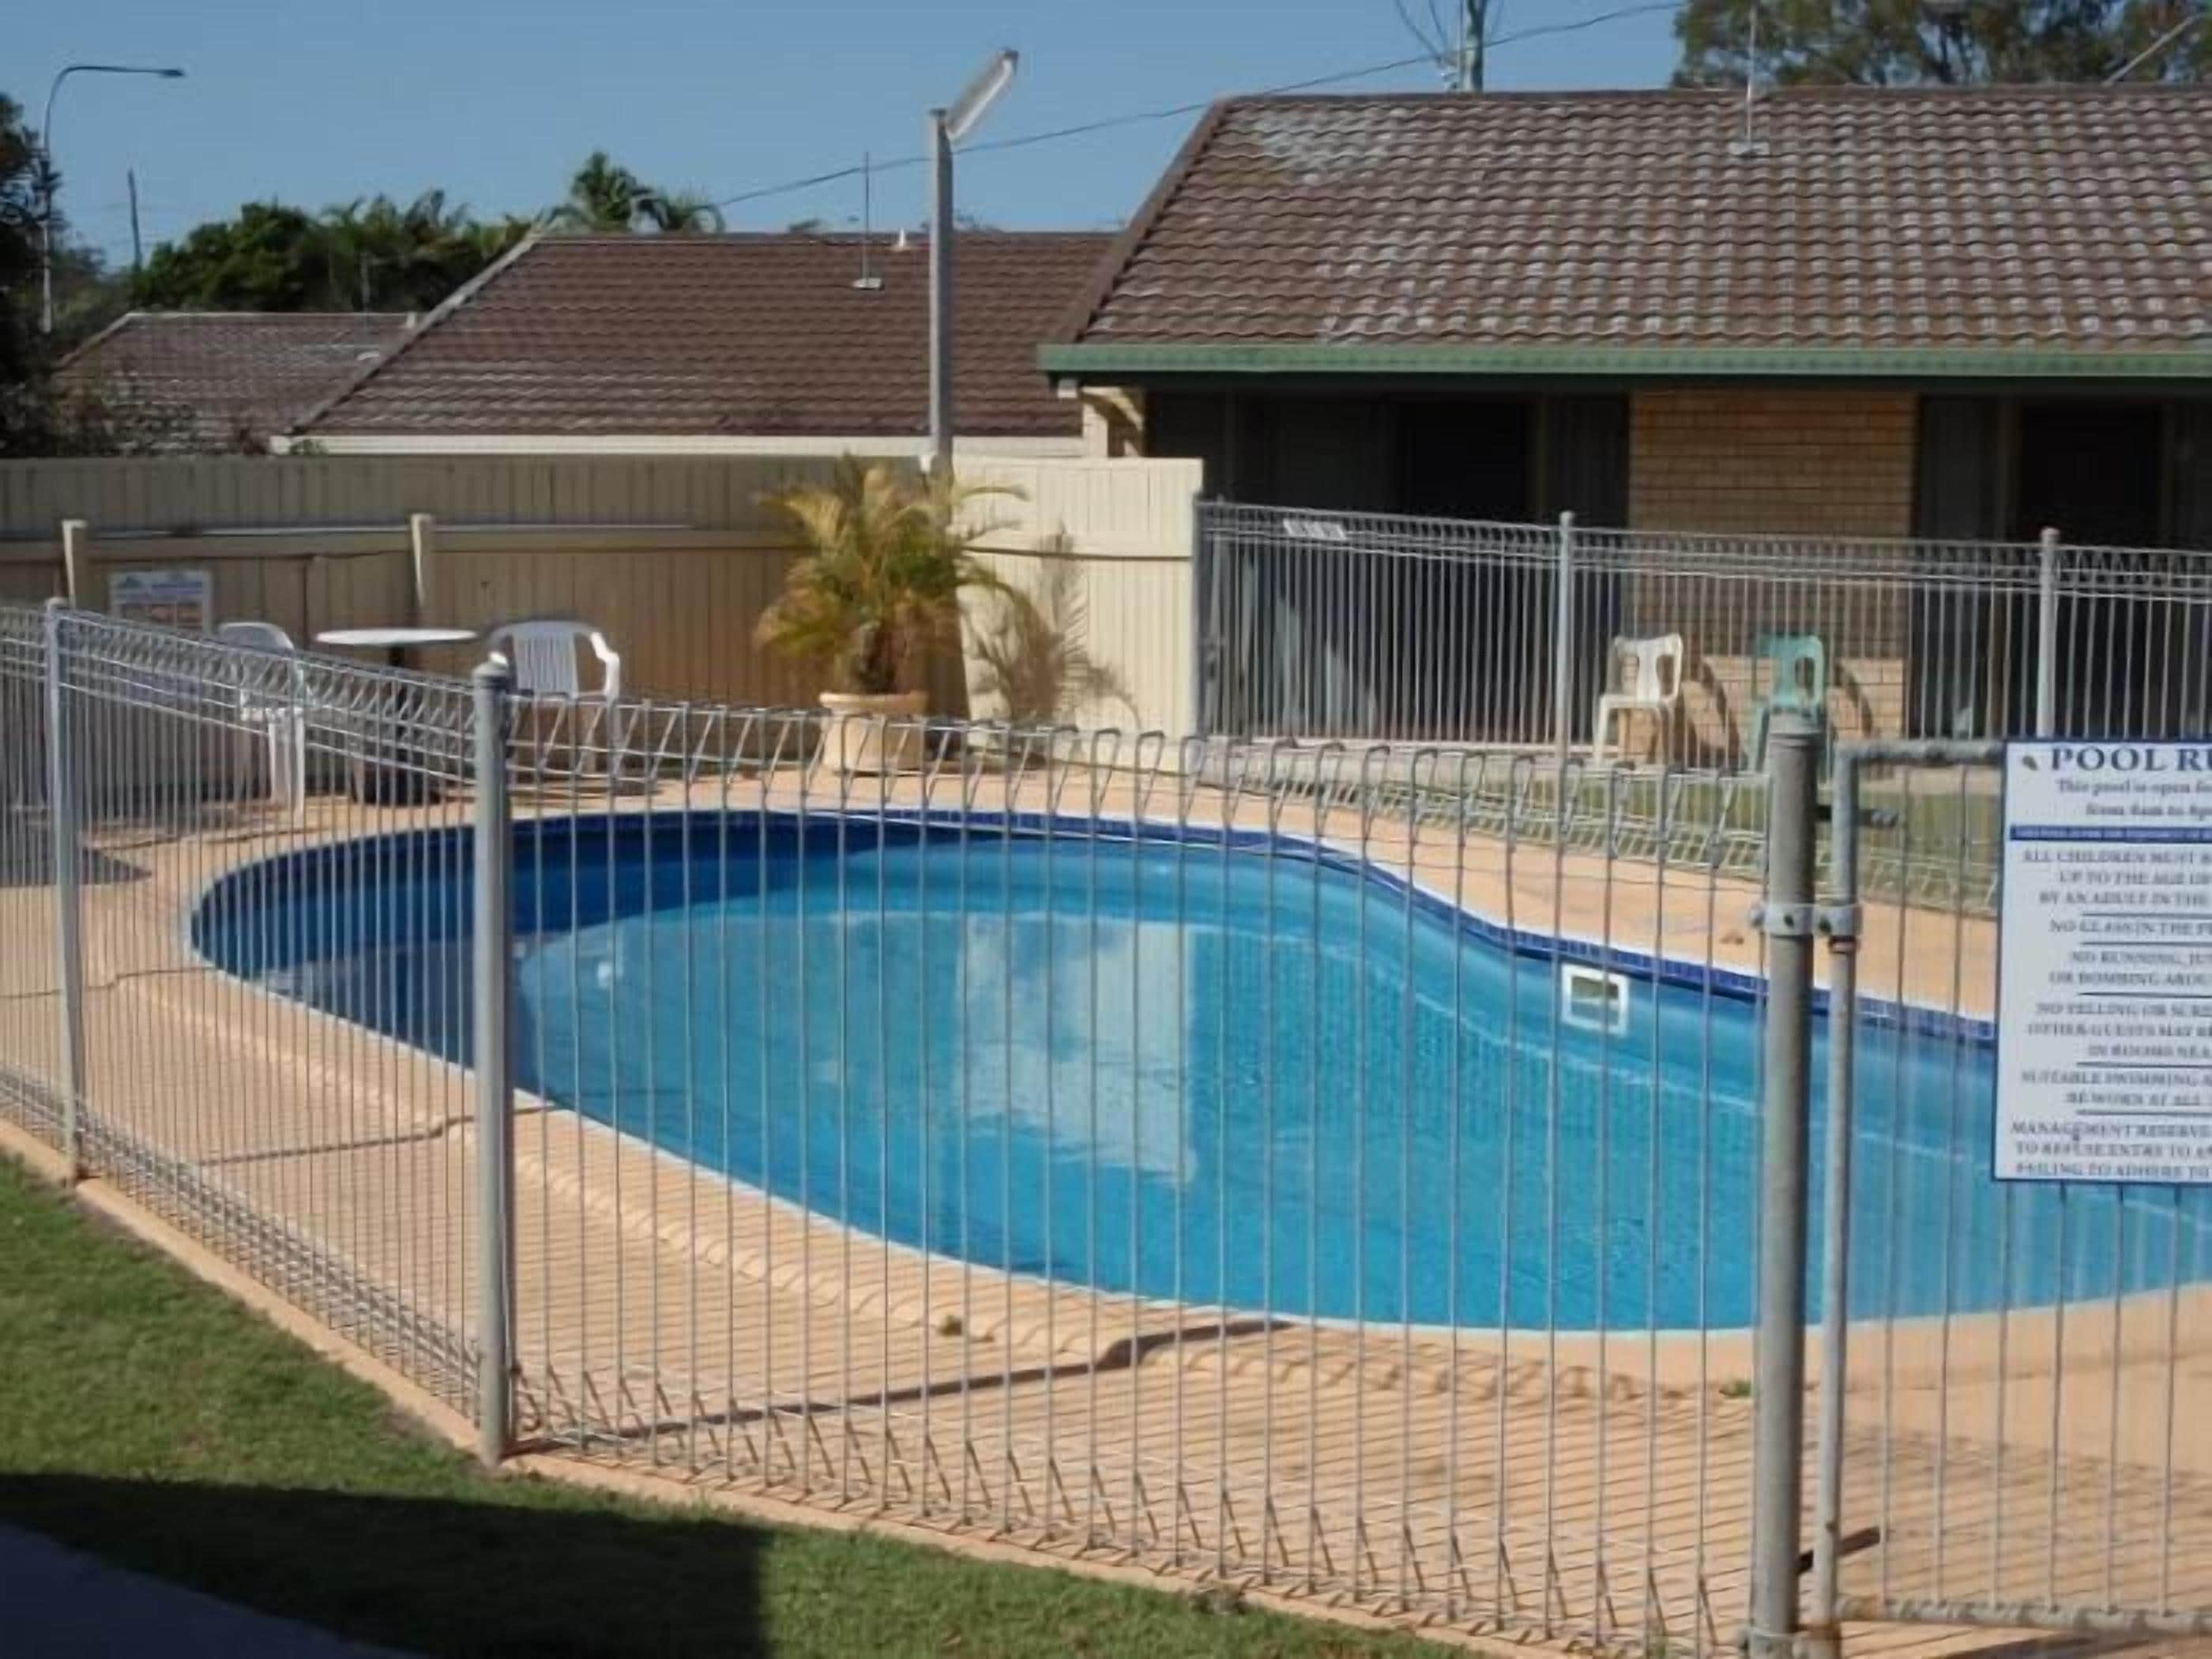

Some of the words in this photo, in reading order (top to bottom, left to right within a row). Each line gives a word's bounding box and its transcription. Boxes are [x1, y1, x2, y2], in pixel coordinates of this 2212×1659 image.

[2052, 748, 2167, 771] POOL
[2177, 748, 2212, 771] R
[2092, 780, 2130, 796] pool
[2086, 803, 2124, 815] from
[2023, 850, 2051, 863] ALL
[2057, 850, 2146, 863] CHILDREN
[2150, 851, 2195, 863] MUST
[2115, 872, 2149, 884] THE
